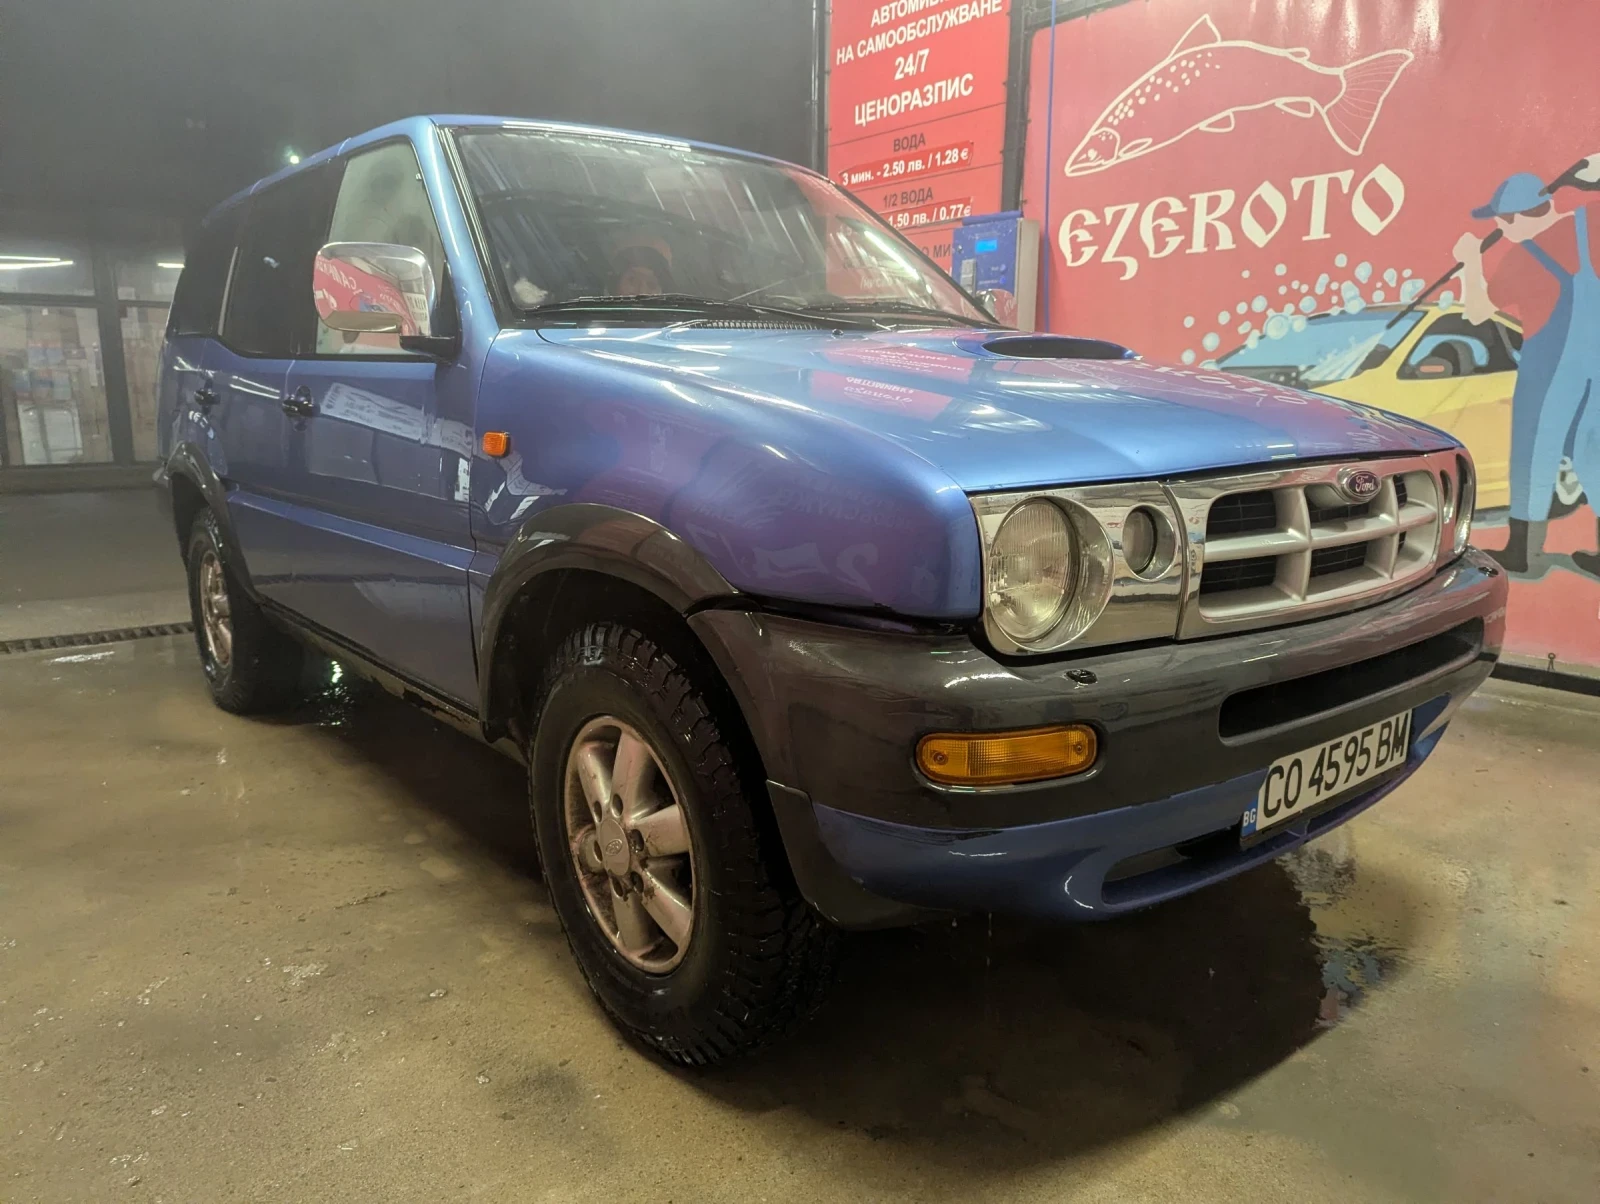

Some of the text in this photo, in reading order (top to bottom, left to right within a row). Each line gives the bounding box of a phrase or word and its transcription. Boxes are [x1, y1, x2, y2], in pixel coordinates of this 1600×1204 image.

[871, 0, 949, 28] АВТОМИ
[836, 0, 1003, 65] НА САМООБСЛУЖВАНЕ
[894, 48, 930, 81] 24/7
[854, 73, 974, 127] ЦЕНОРАЗПИС
[893, 132, 926, 152] ВОДА
[842, 172, 849, 186] 3
[850, 170, 874, 184] мин.
[883, 160, 905, 178] 2.50
[907, 159, 925, 173] лв.
[927, 152, 933, 169] /
[883, 187, 934, 208] 1/2 ВОДА
[912, 212, 930, 225] лв.
[1058, 163, 1405, 281] EZEROTO
[933, 244, 951, 258] МИ
[1355, 475, 1375, 492] Ford
[1243, 712, 1409, 827] BG CO 4595 BM
